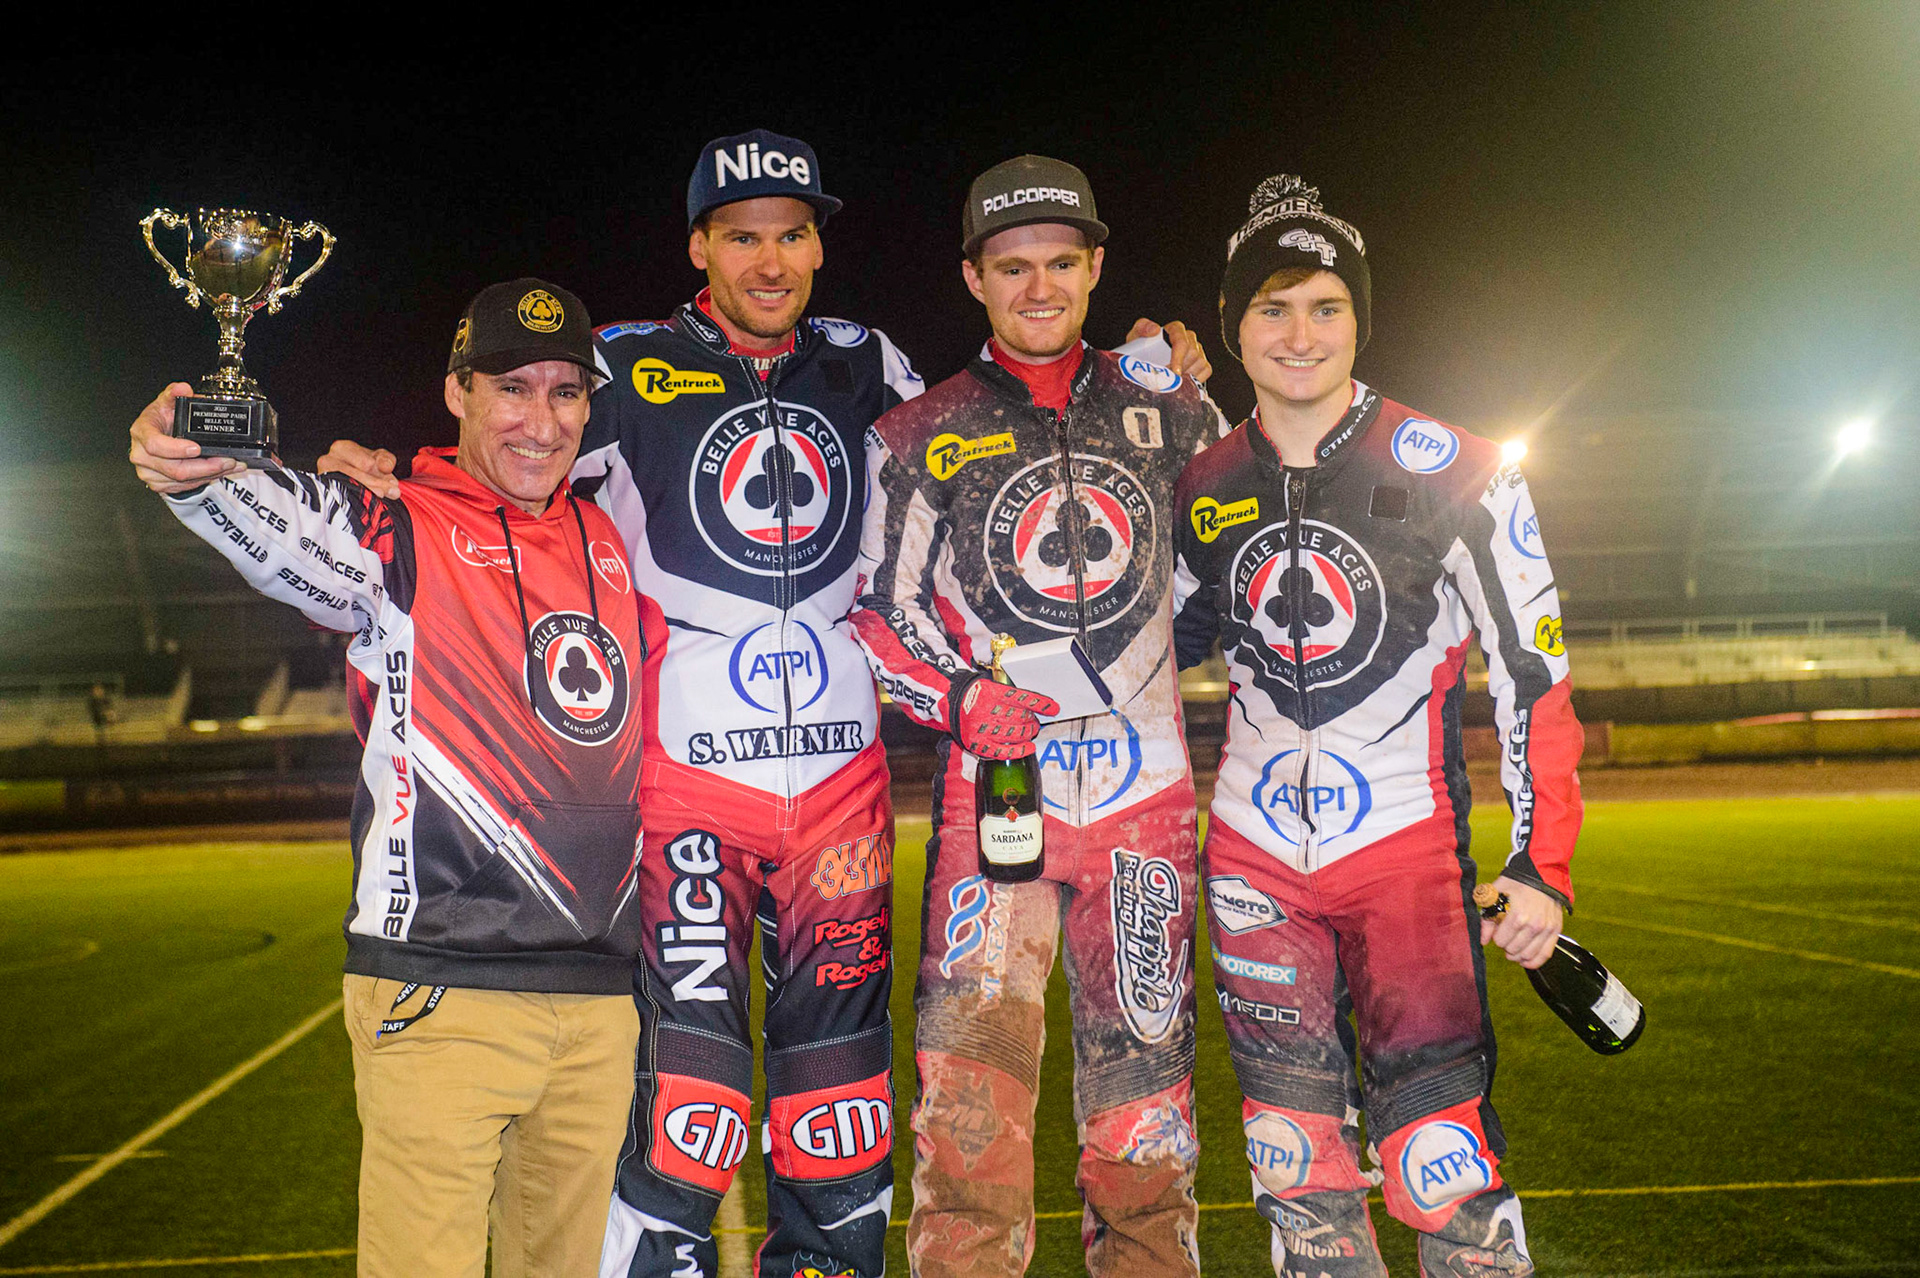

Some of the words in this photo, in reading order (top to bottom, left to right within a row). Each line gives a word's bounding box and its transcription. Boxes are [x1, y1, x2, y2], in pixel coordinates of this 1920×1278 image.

[715, 142, 811, 188] Nice
[982, 187, 1080, 216] POLCOPPER
[639, 367, 721, 394] Rentruck
[203, 424, 236, 432] WINNER
[1402, 430, 1447, 457] ATPI
[702, 418, 750, 475] BELLE
[806, 421, 841, 468] ACES
[931, 441, 1013, 475] Rentruck
[220, 476, 289, 534] THEACES
[994, 475, 1043, 535] BELLE
[1105, 473, 1146, 518] ACES
[1195, 505, 1257, 535] Rentruck
[1237, 539, 1274, 595] BELLE
[1329, 544, 1373, 592] ACES
[1039, 596, 1119, 620] MANCSTER
[534, 620, 560, 661] BELLE
[563, 618, 589, 633] VUE
[747, 650, 813, 682] ATPI
[386, 650, 408, 745] ACES
[563, 720, 610, 735] MANCHESTER
[1040, 738, 1118, 772] ATPI
[391, 755, 410, 826] VUE
[1269, 782, 1345, 815] ATPI
[991, 832, 1034, 844] SARDANA
[384, 838, 411, 938] BELLE
[1119, 856, 1140, 925] Racing
[660, 832, 730, 1002] Nice
[1221, 955, 1293, 984] MOTOREX
[396, 982, 418, 1003] TAFF
[427, 985, 445, 1009] STAF
[790, 1097, 890, 1160] GM
[1246, 1136, 1295, 1170] ATPI
[1420, 1147, 1470, 1193] ATPI
